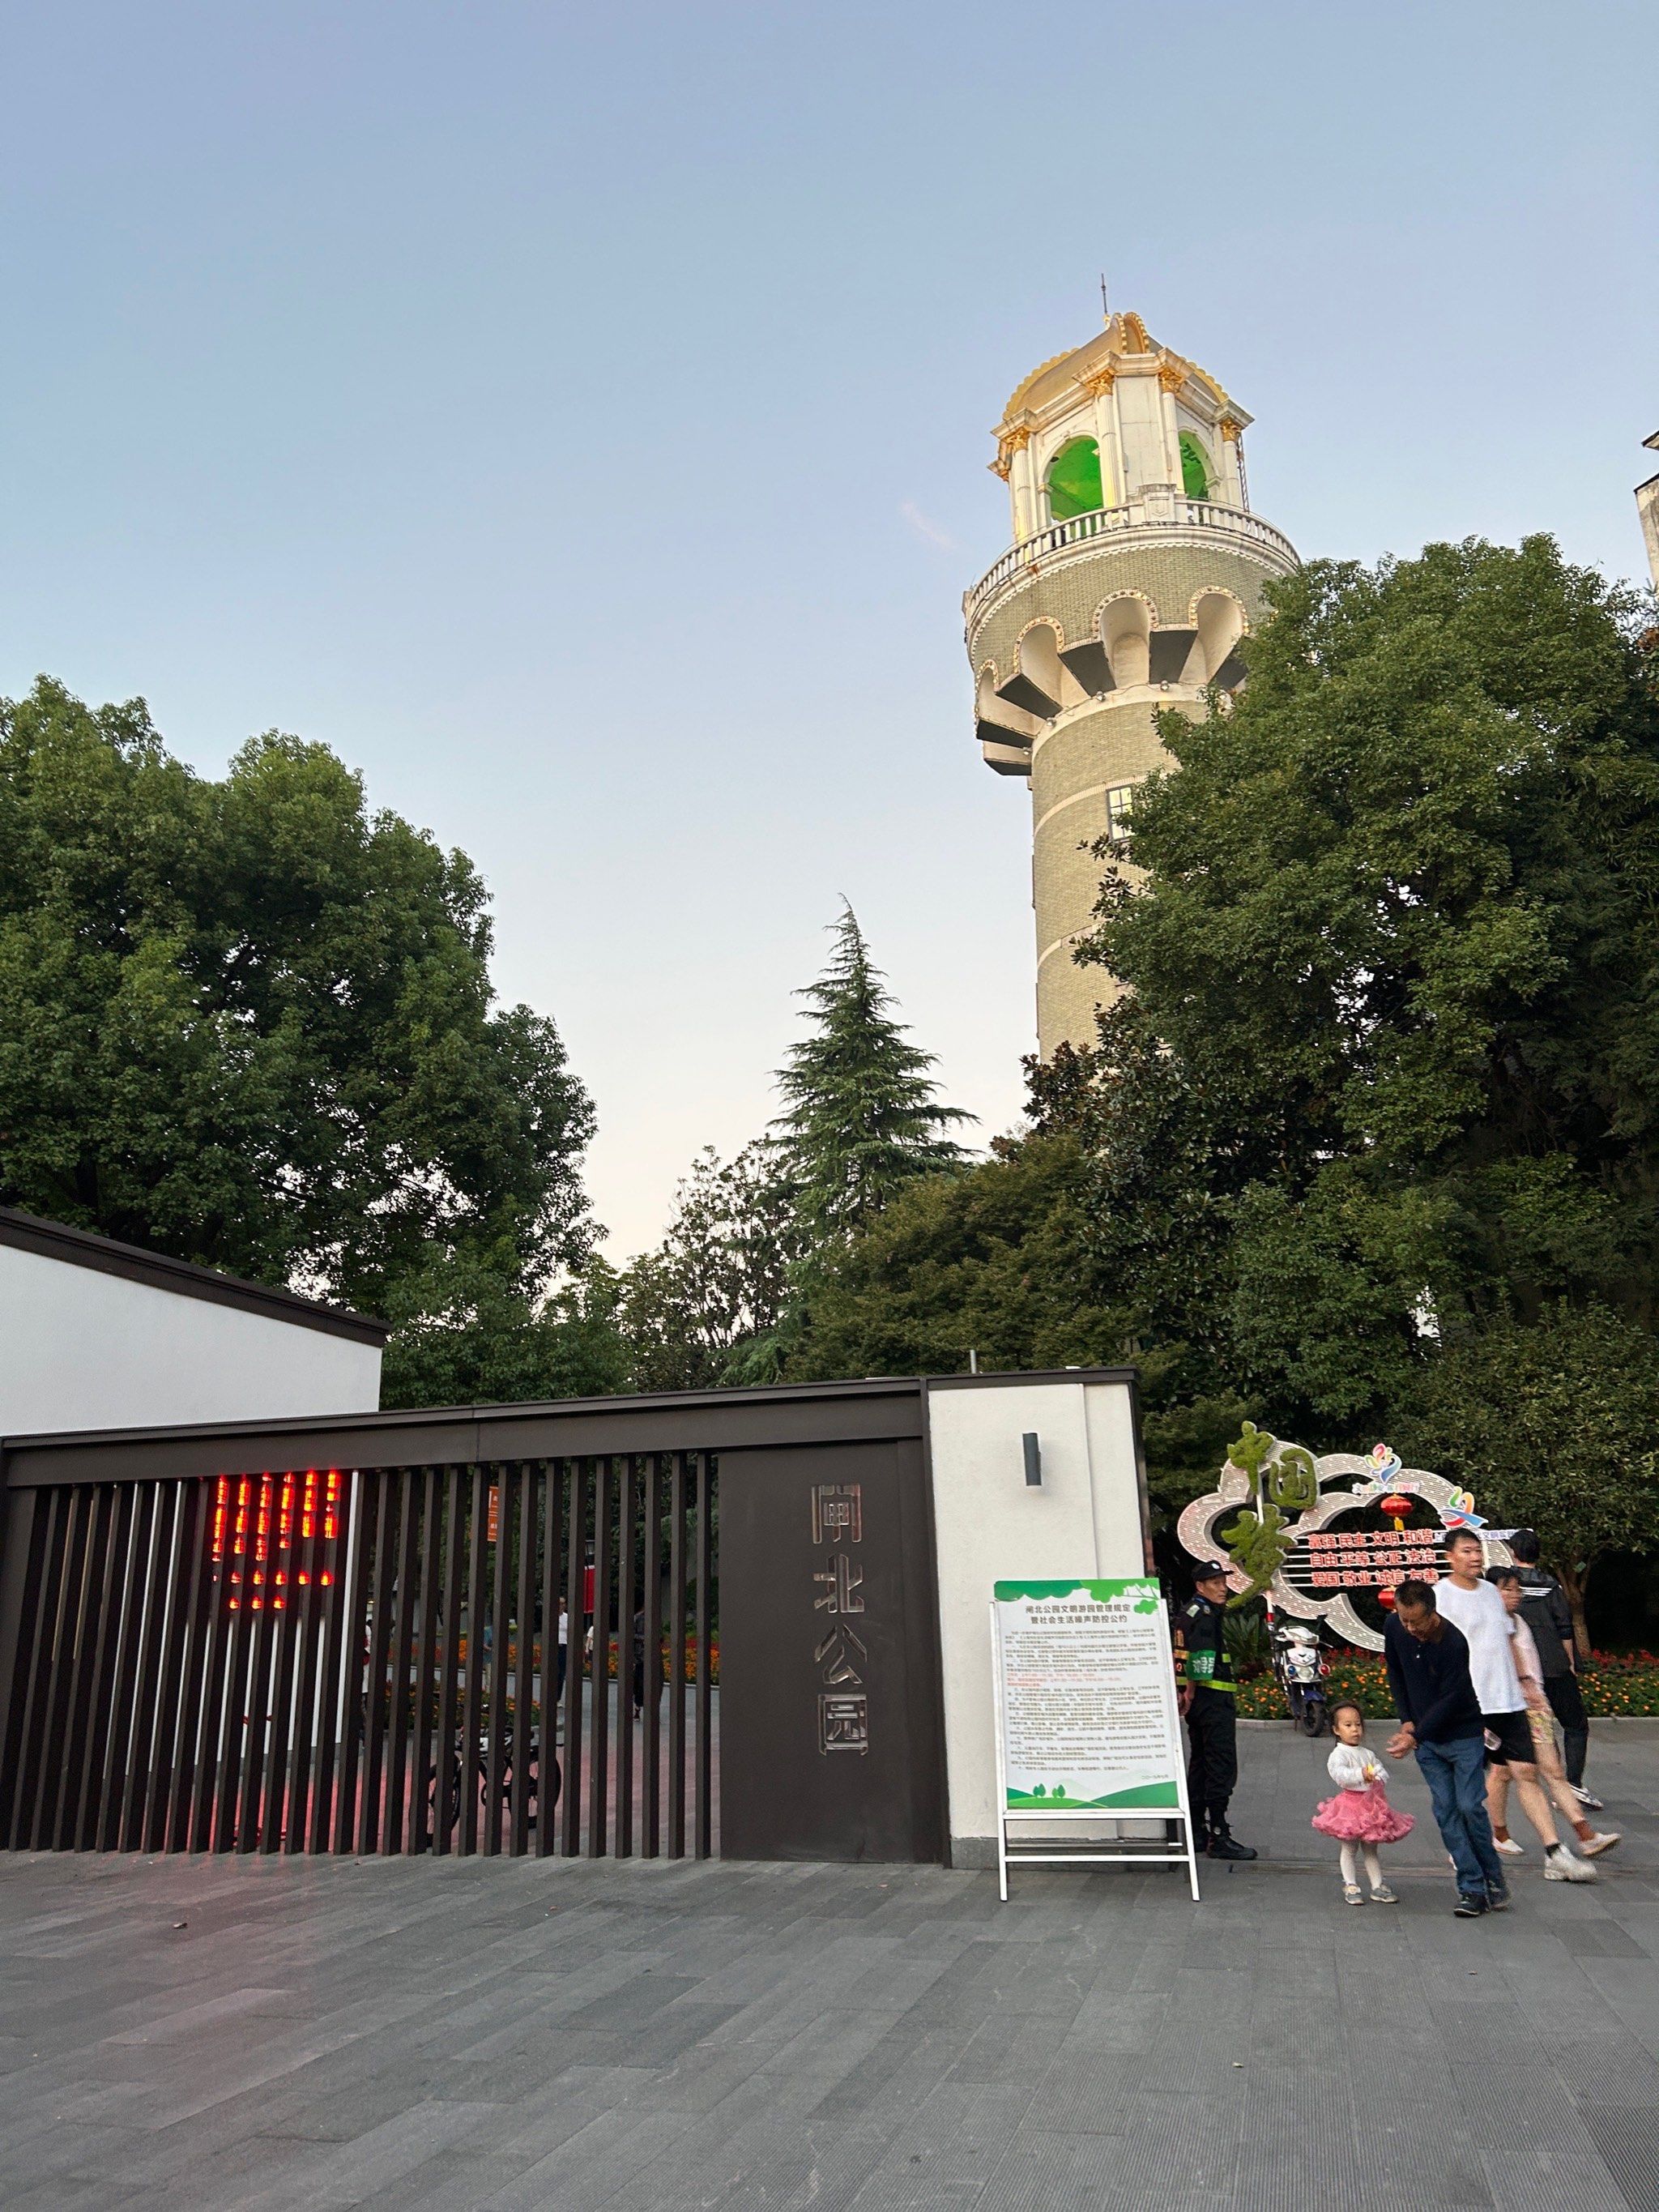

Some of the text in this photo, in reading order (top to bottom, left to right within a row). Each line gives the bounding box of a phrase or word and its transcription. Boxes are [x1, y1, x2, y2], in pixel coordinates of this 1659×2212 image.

[1308, 1534, 1336, 1549] 富强
[1338, 1532, 1367, 1548] 民主
[1371, 1531, 1400, 1546] 文明
[1403, 1529, 1434, 1545] 和谐
[1310, 1548, 1436, 1567] 自由 平等 公正 法治
[1311, 1571, 1340, 1586] 爱国
[1342, 1570, 1372, 1586] 敬业
[1375, 1569, 1405, 1586] 诚信
